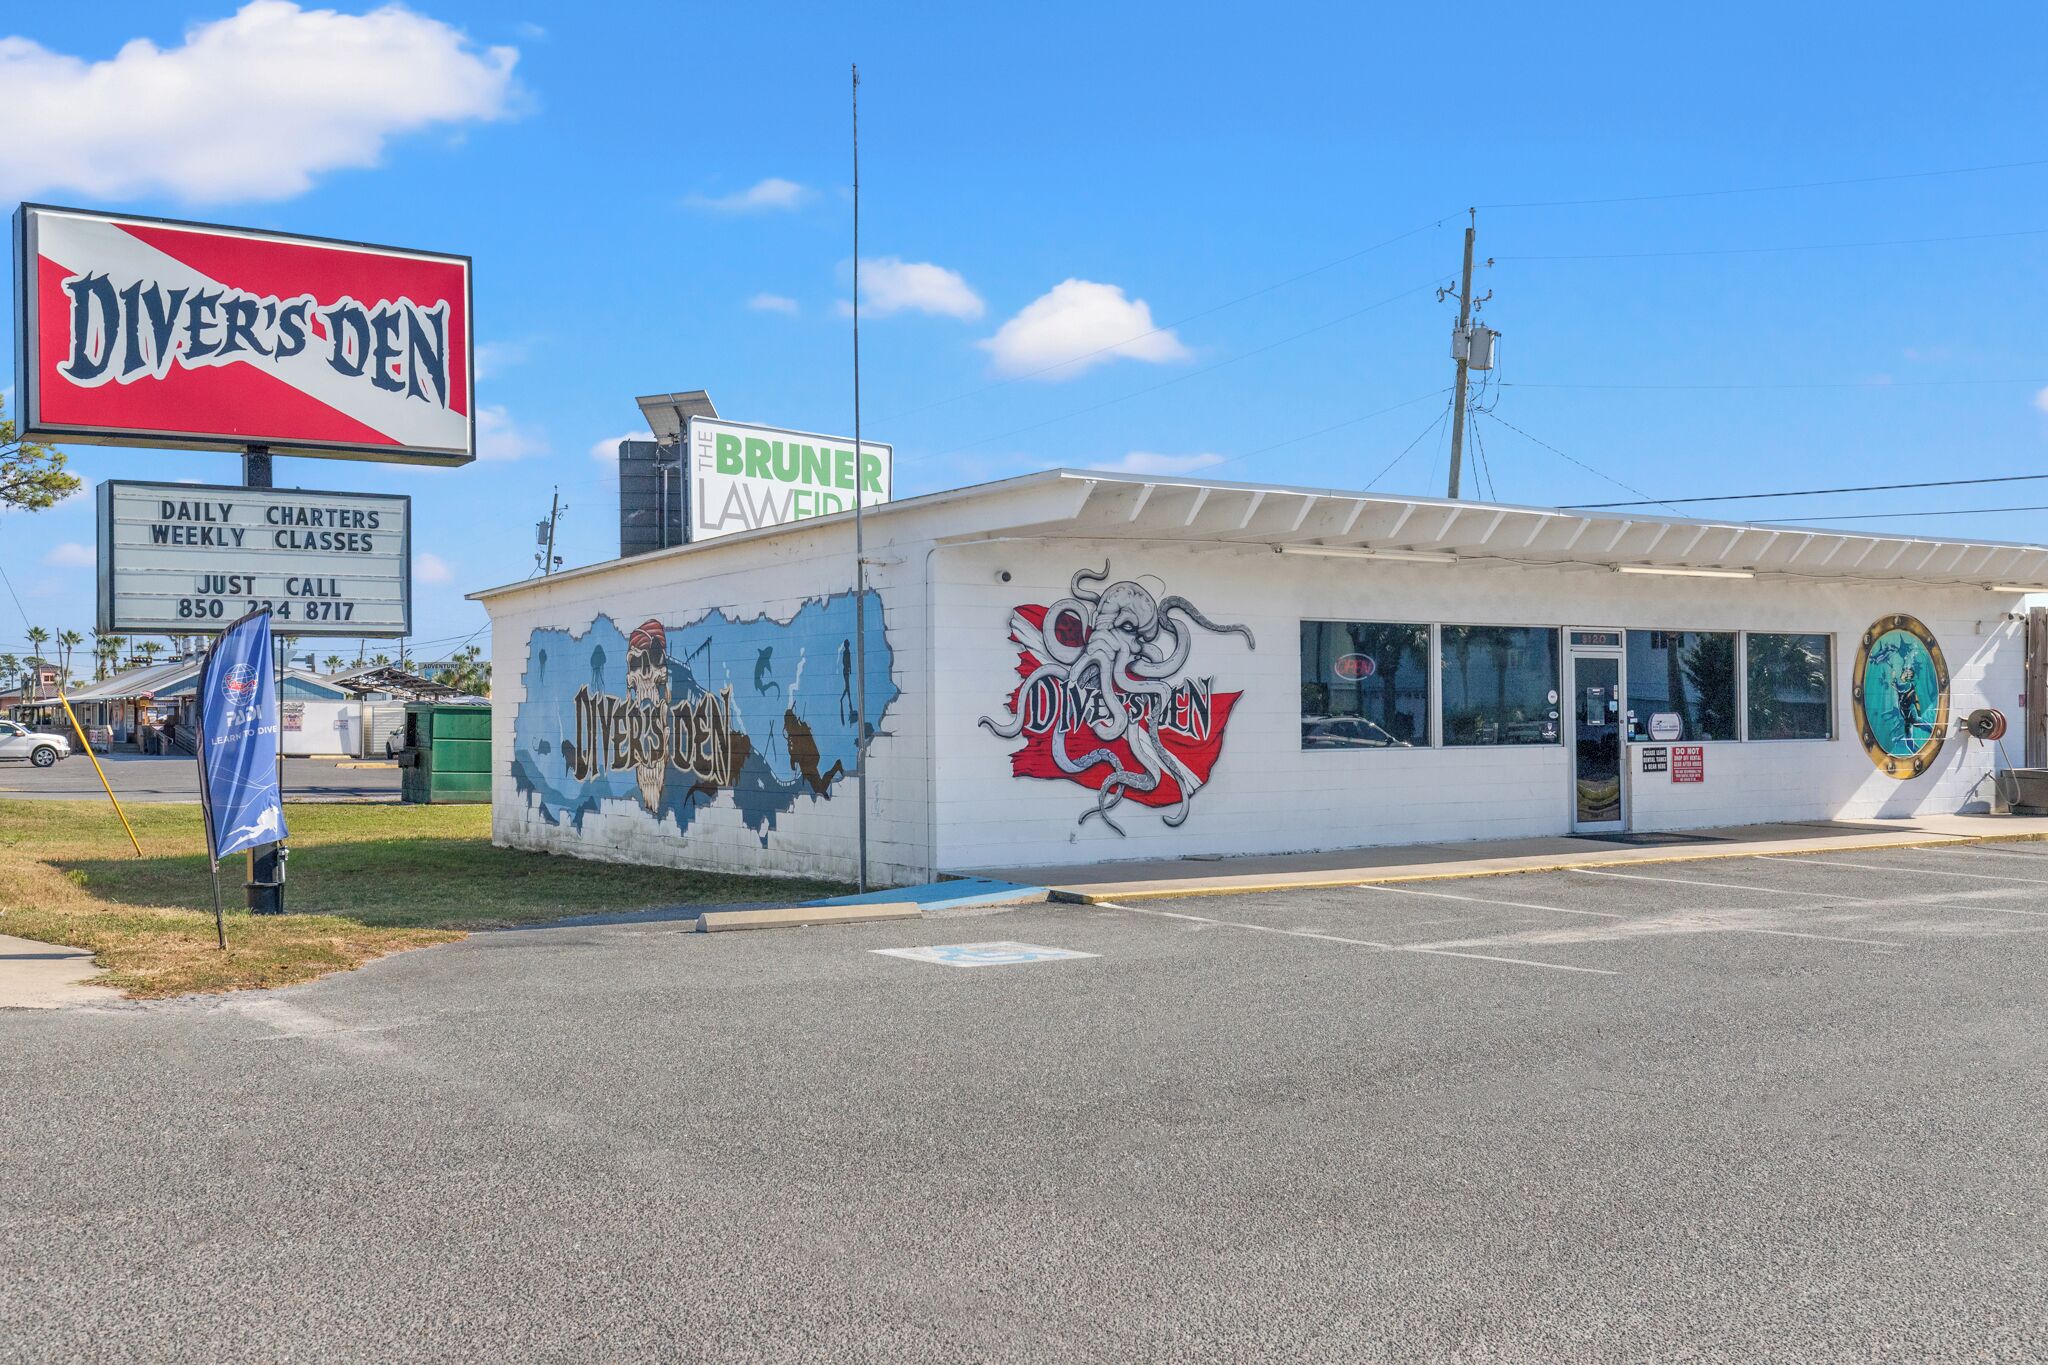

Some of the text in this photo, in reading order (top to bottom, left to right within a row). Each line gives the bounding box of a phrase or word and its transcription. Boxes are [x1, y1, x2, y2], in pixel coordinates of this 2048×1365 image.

[63, 270, 446, 409] DIVER'S DEN
[698, 430, 713, 472] THE
[716, 432, 884, 493] BRUNER
[161, 500, 380, 529] DAILY CHARTERS
[151, 524, 373, 552] WEEKLY CLASSES
[197, 575, 341, 597] JUST CALL
[178, 599, 224, 619] 850
[305, 602, 355, 620] 8717
[226, 704, 262, 727] PADI
[211, 725, 278, 745] LEARN TO DIVE
[671, 685, 732, 786] DEN
